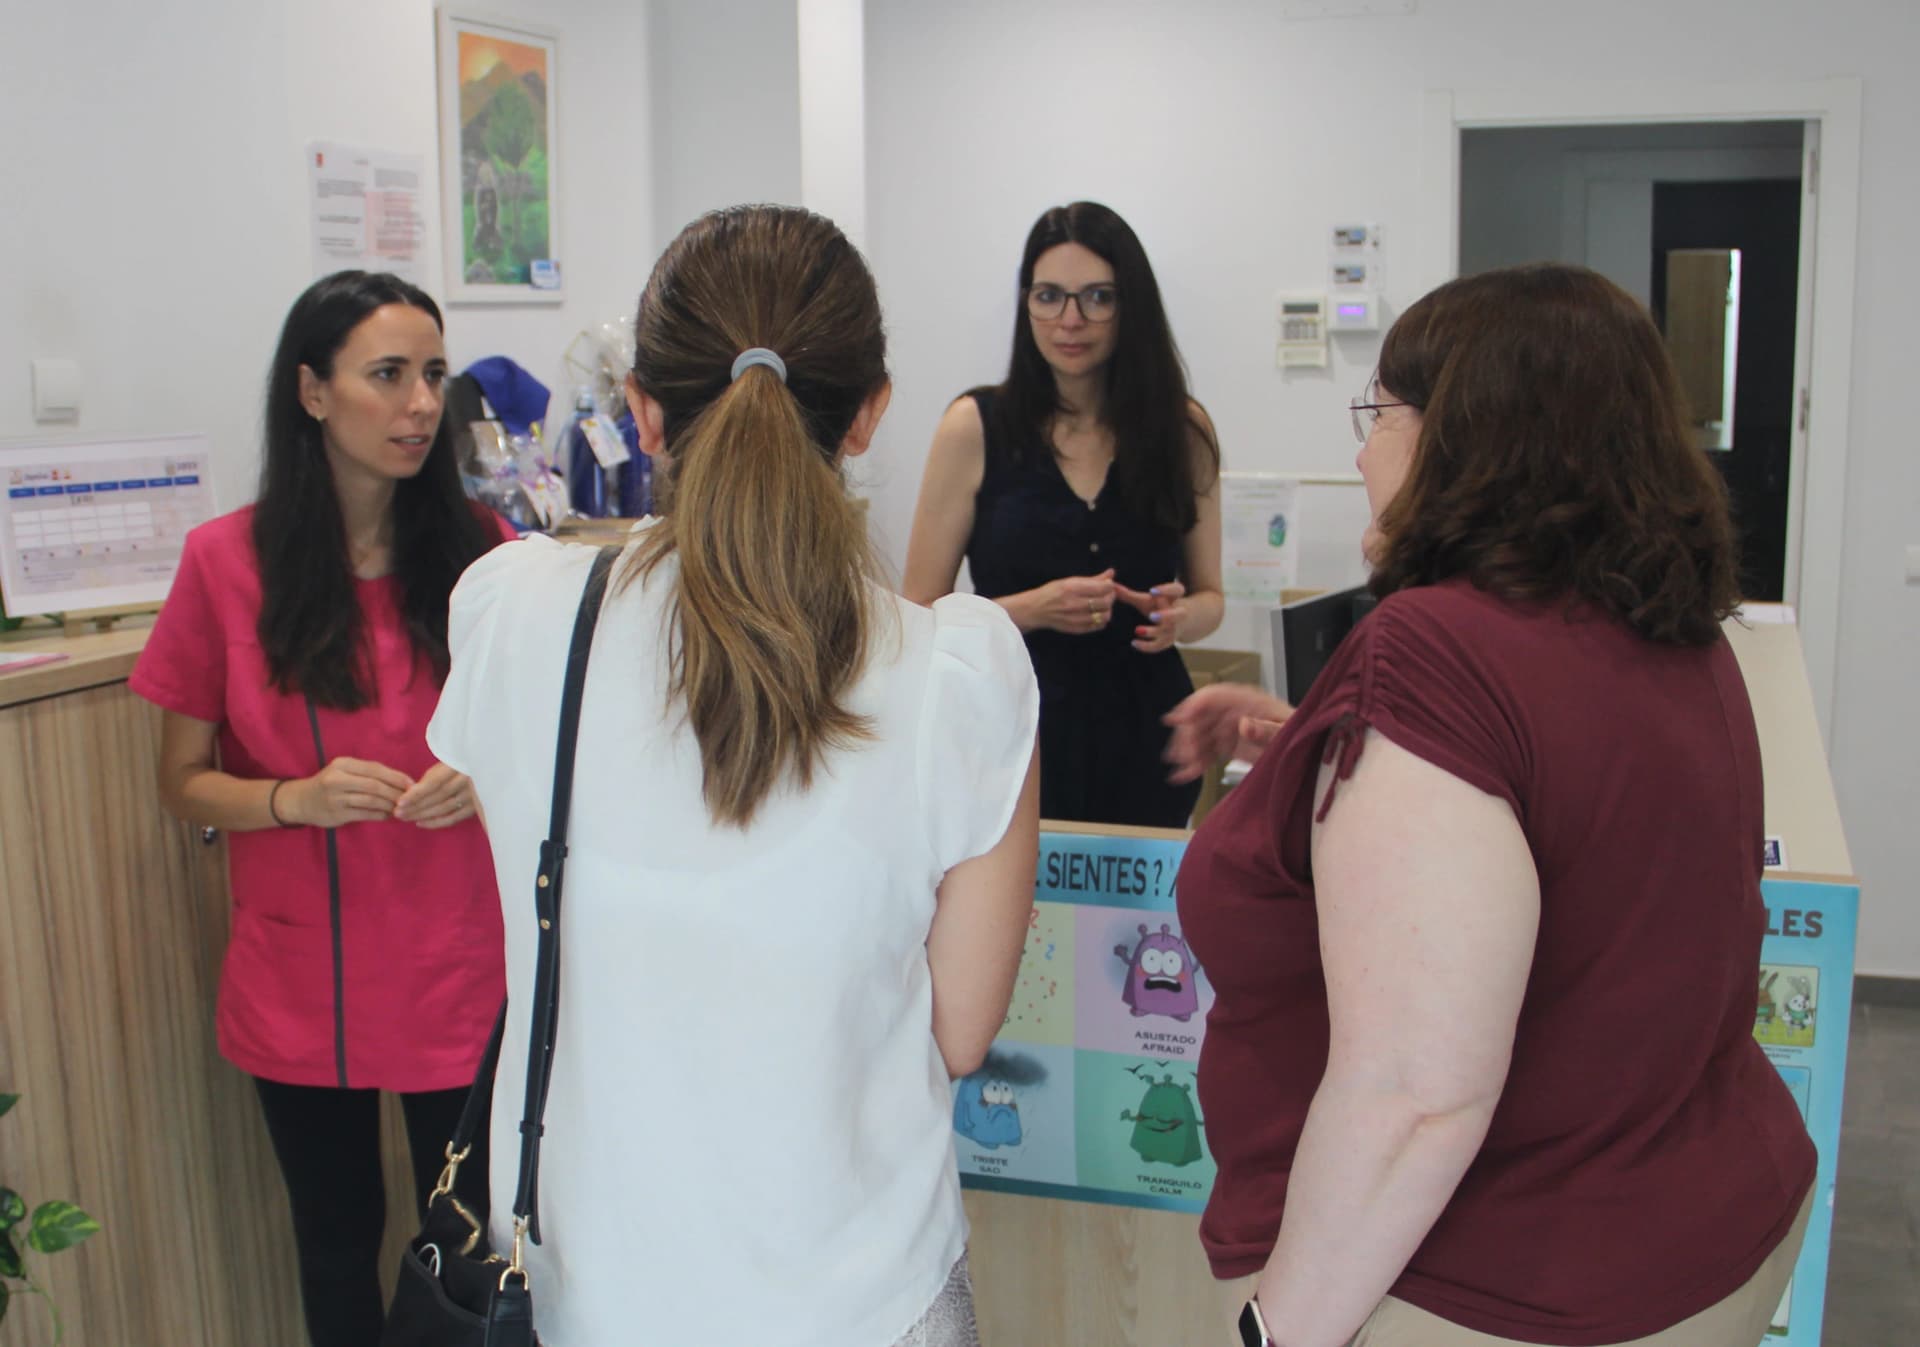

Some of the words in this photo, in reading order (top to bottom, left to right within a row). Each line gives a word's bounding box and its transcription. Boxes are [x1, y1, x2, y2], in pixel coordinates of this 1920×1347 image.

[1046, 851, 1148, 896] SIENTES
[1135, 1030, 1197, 1045] ASUSTADO
[1142, 1042, 1185, 1055] AFRAID
[971, 1154, 1008, 1167] TRISTE
[979, 1164, 1001, 1174] SAD
[1137, 1174, 1202, 1190] TRANQUILO
[1149, 1184, 1182, 1195] CALM
